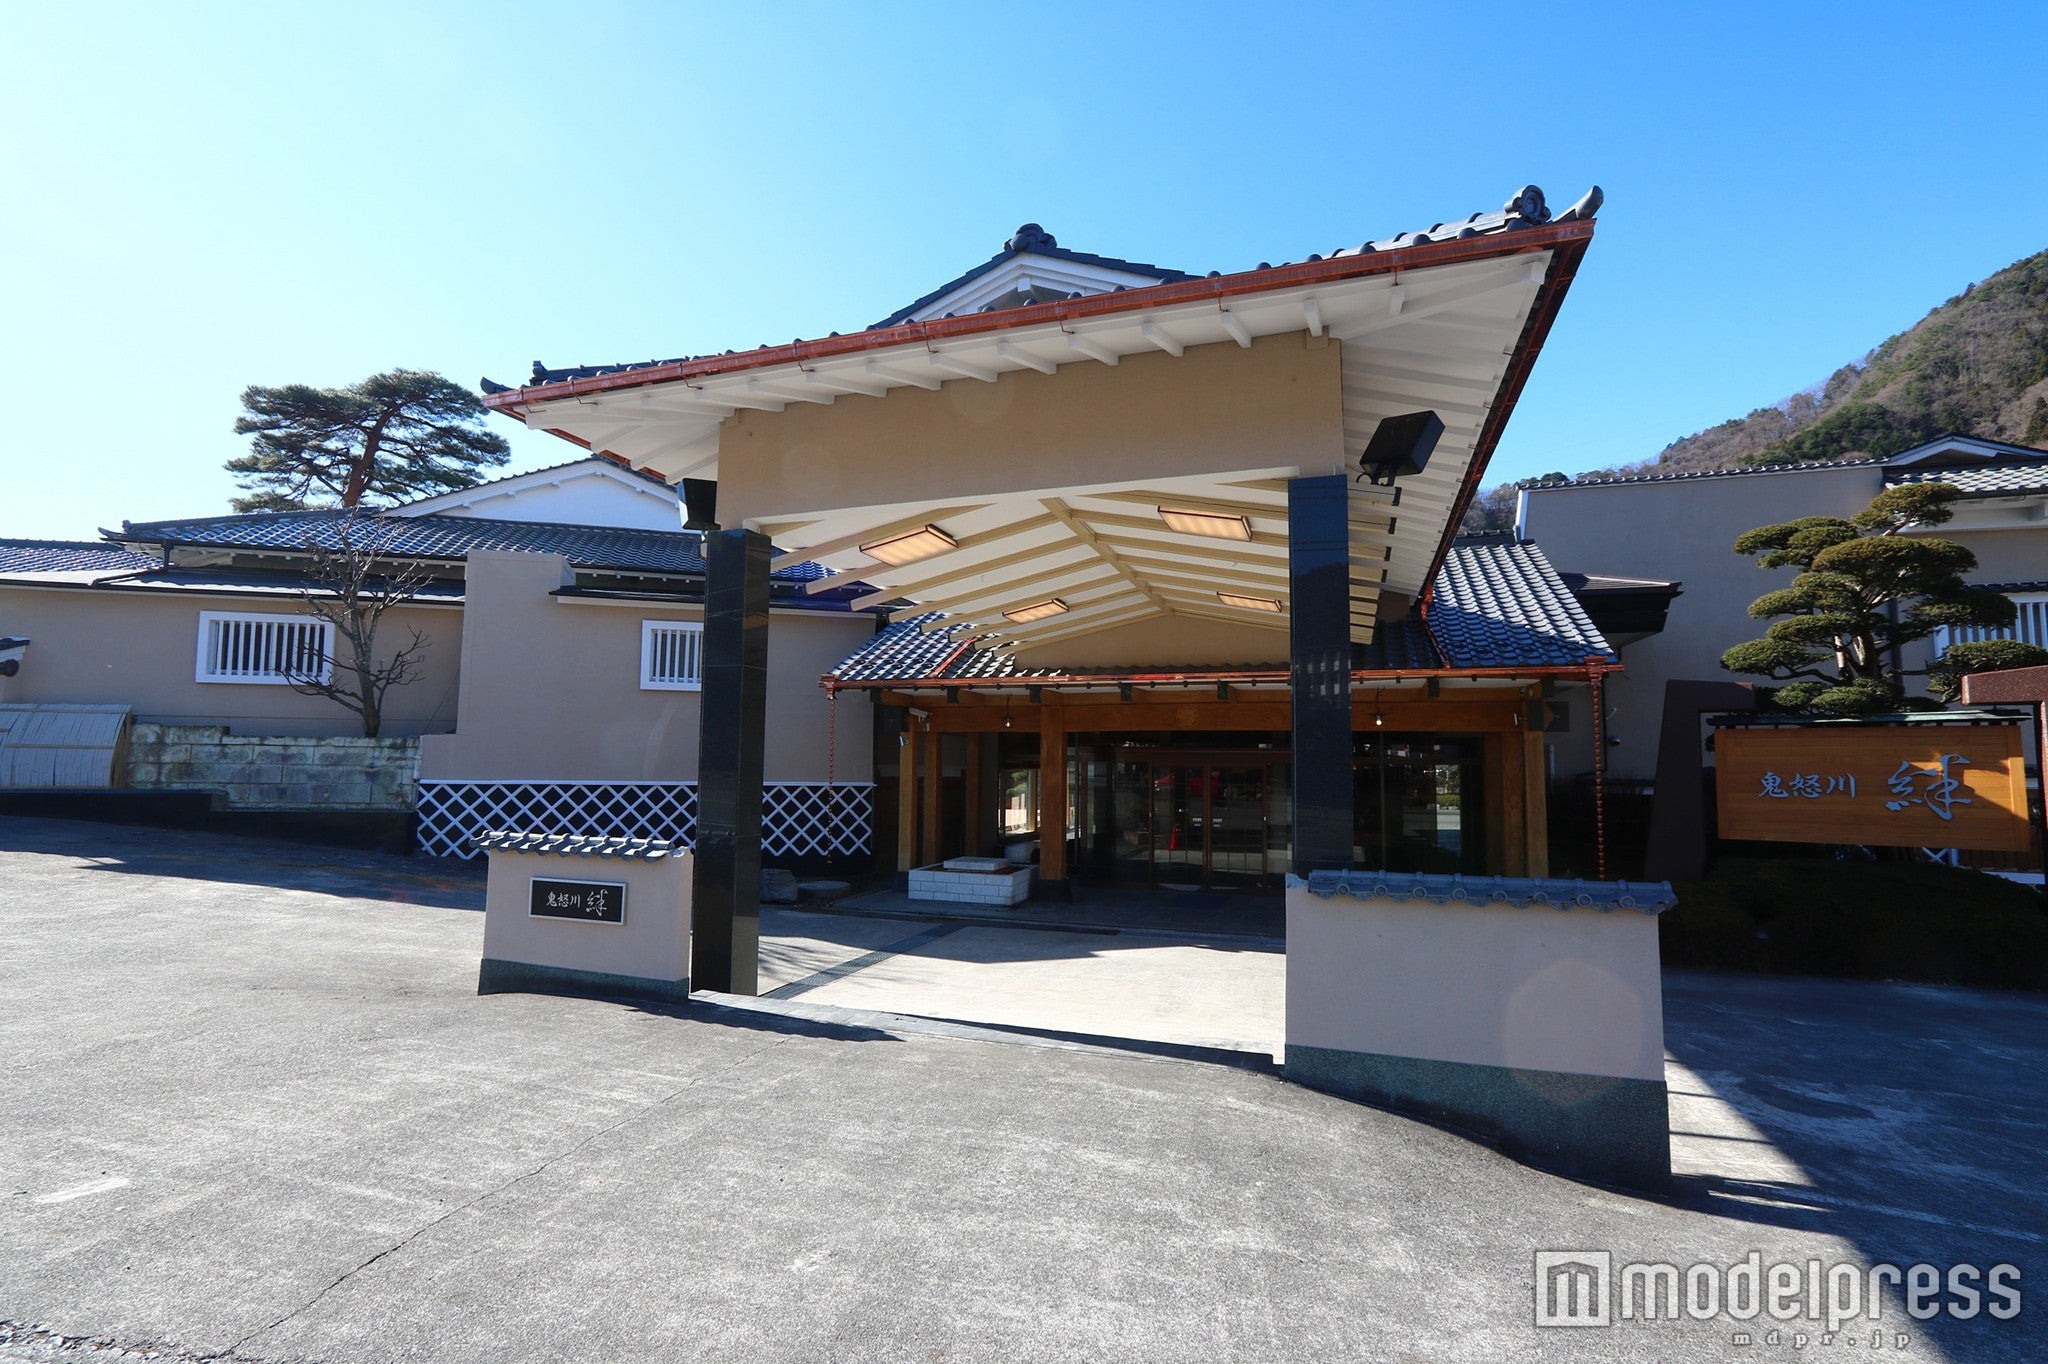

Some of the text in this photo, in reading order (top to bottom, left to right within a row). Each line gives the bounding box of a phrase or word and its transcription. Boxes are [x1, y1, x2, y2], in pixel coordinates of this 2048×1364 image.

[1757, 754, 1972, 820] 鬼怒川 絆
[546, 888, 609, 917] 鬼怒川 絆
